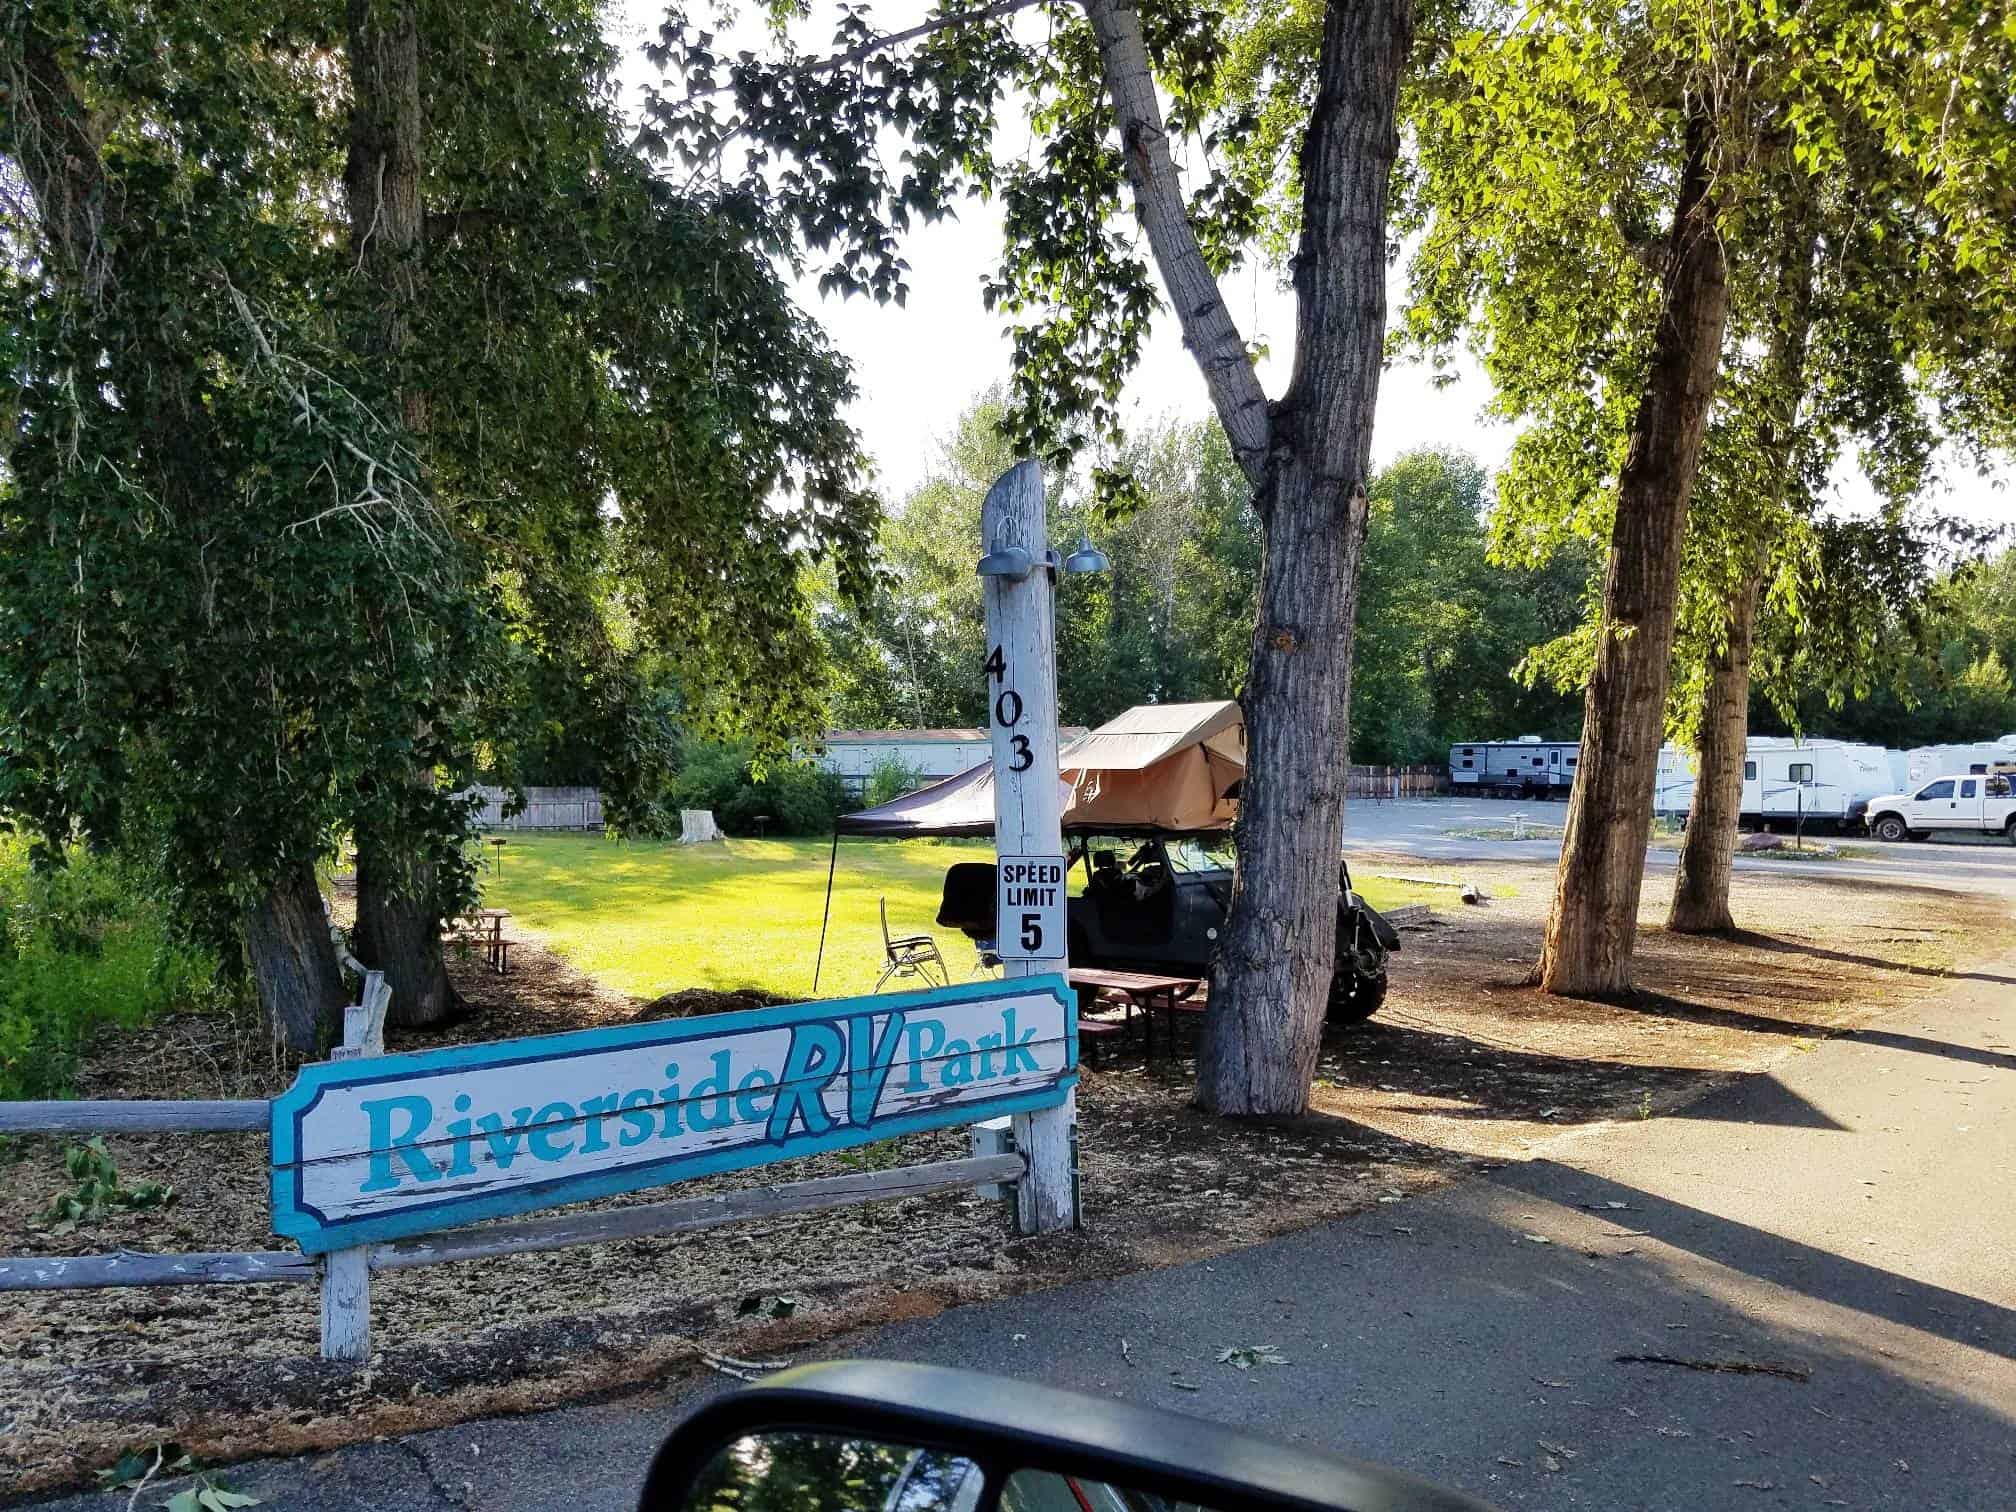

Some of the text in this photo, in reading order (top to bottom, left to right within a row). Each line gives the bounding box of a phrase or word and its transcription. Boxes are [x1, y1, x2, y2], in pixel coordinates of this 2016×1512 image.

[1003, 864, 1060, 884] SPEED
[1007, 888, 1056, 906] LIMIT
[1021, 913, 1042, 951] 5
[359, 1007, 1040, 1193] Riverside RV Park
